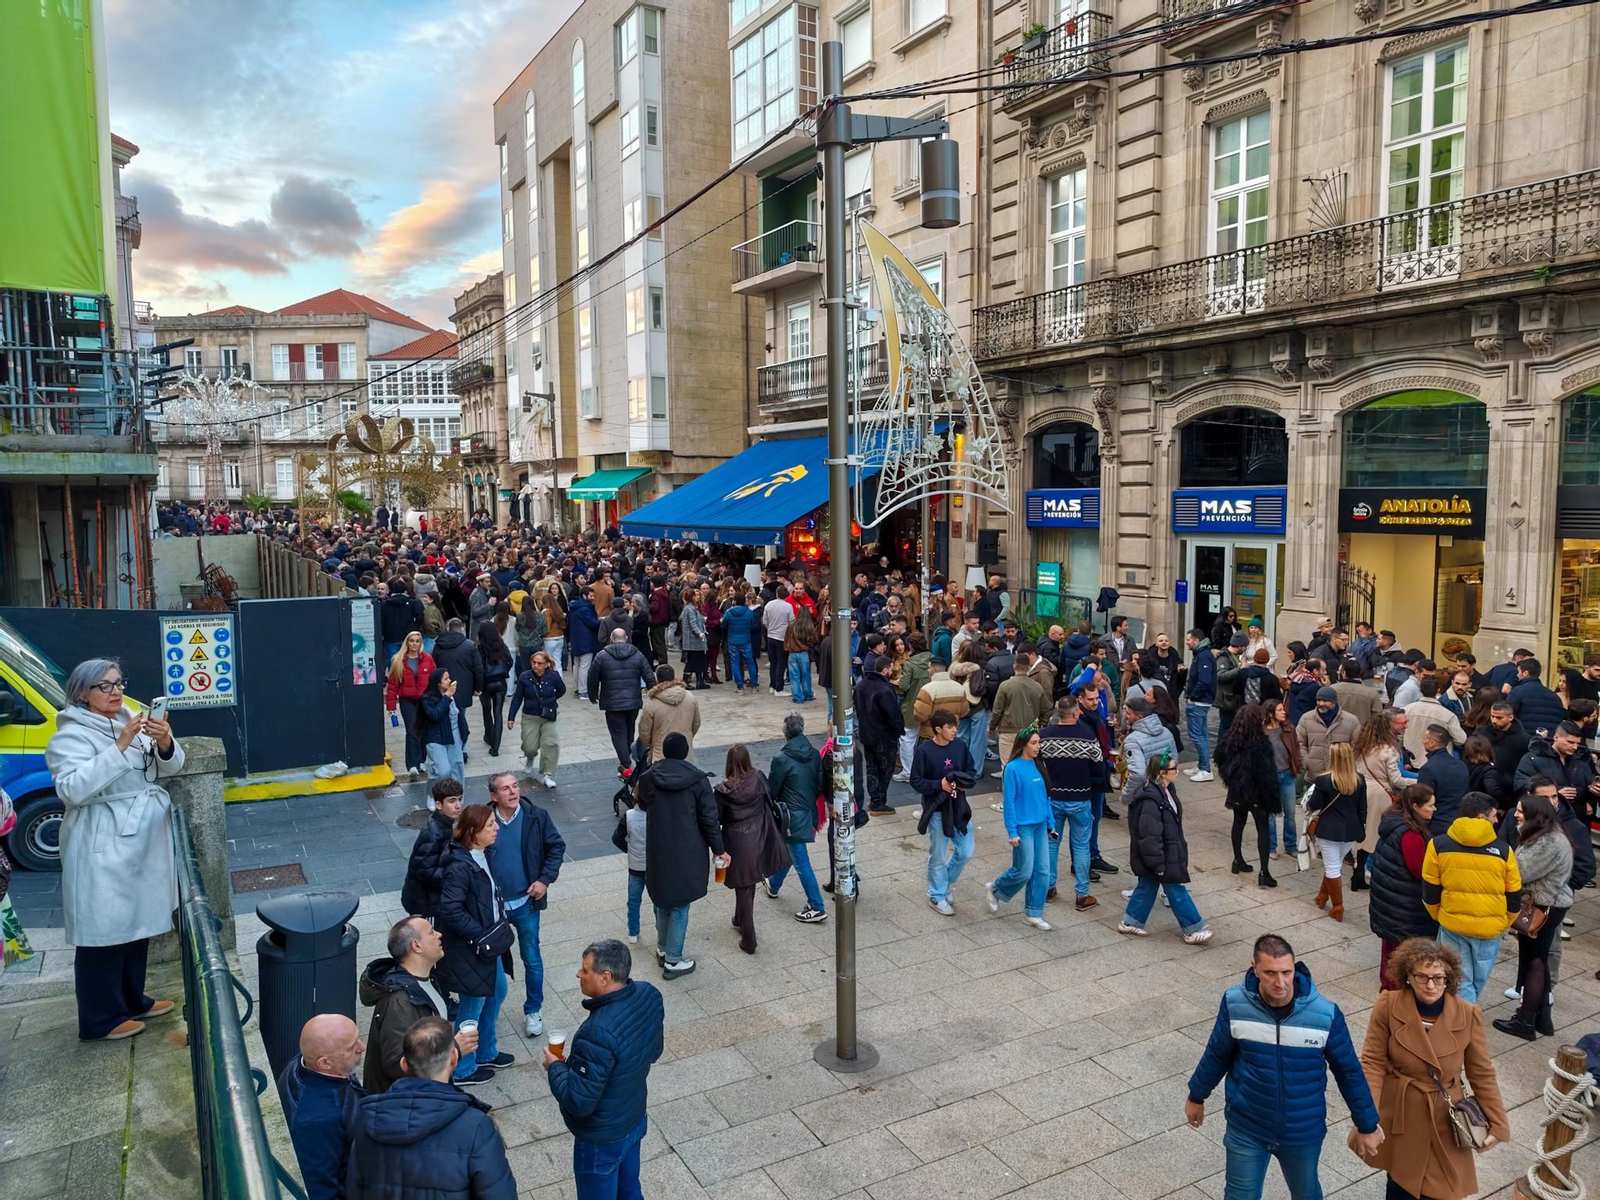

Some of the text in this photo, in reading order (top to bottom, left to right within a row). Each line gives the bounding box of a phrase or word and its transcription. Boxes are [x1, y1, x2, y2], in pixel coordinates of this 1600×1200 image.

[1043, 499, 1081, 511] MAS
[1201, 500, 1252, 514] MAS
[1201, 514, 1252, 522] PREVENCIÓN
[1505, 587, 1516, 600] 4
